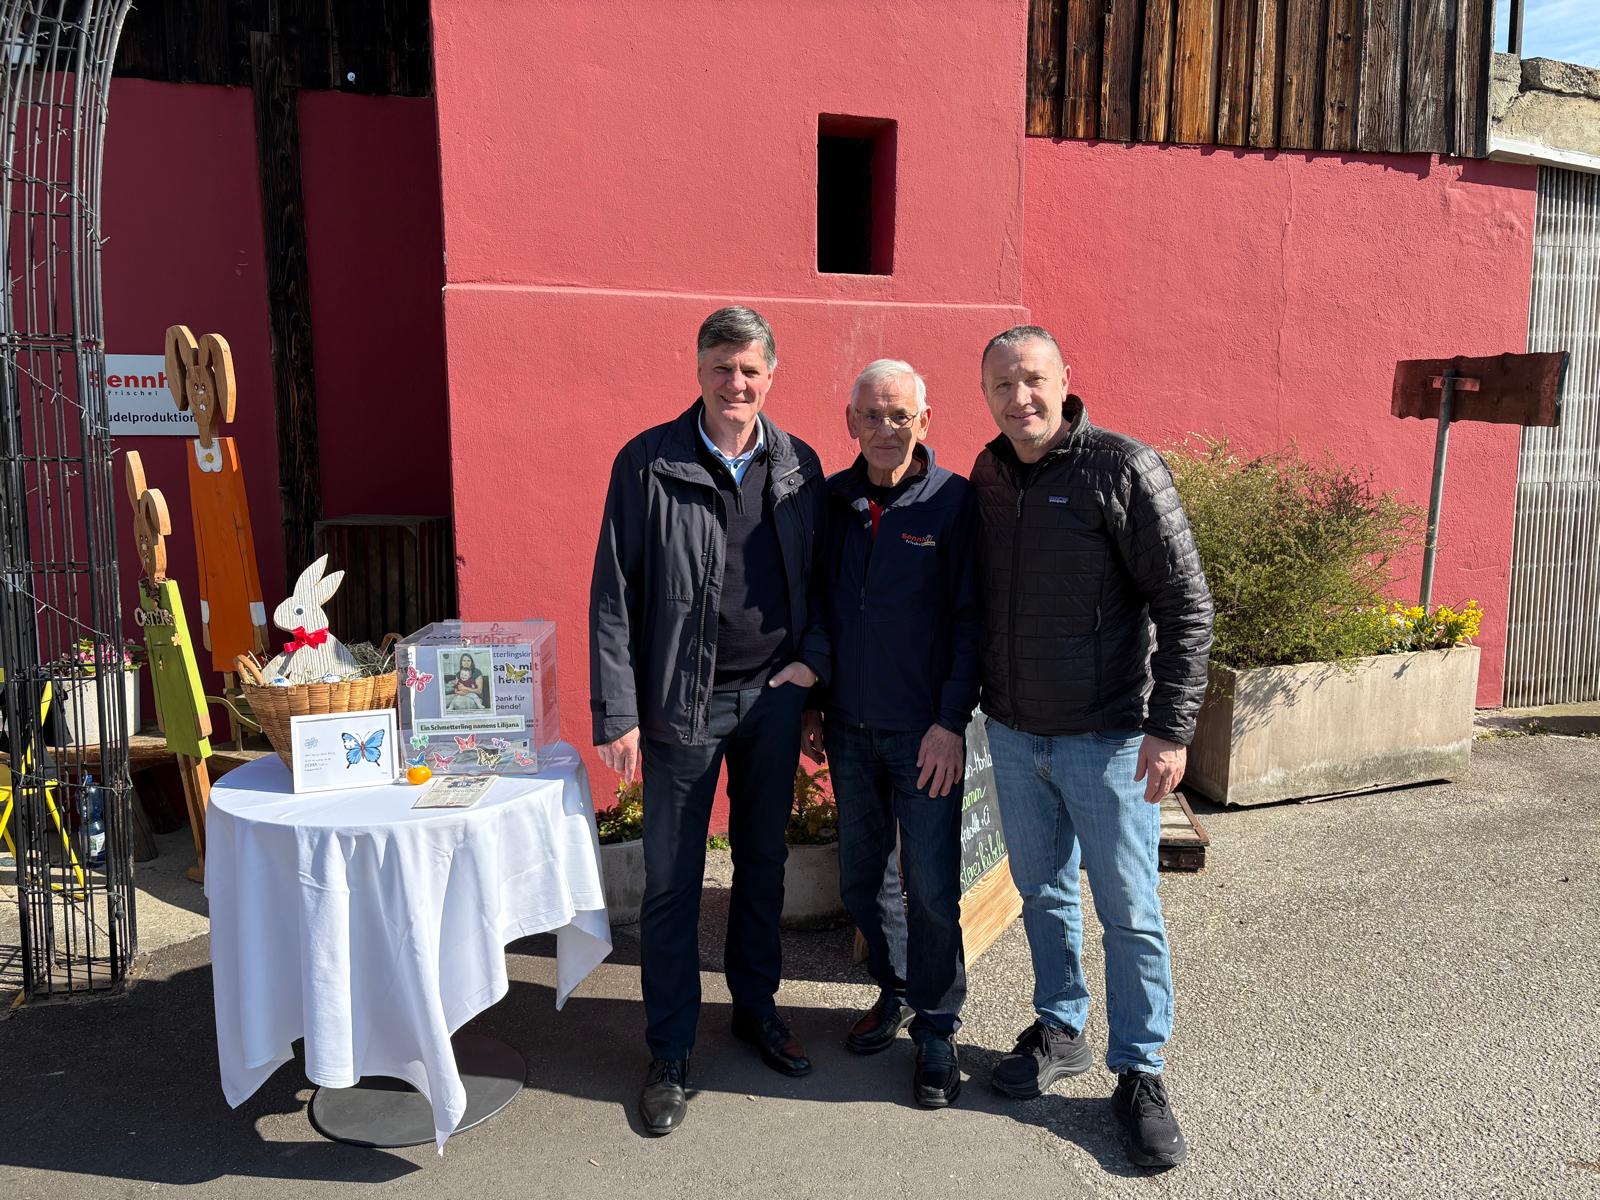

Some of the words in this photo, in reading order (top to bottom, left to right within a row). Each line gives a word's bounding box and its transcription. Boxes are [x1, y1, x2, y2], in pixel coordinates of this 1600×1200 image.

[98, 412, 196, 424] udelproduktion
[431, 722, 473, 732] Schmetterling
[472, 720, 497, 730] namens
